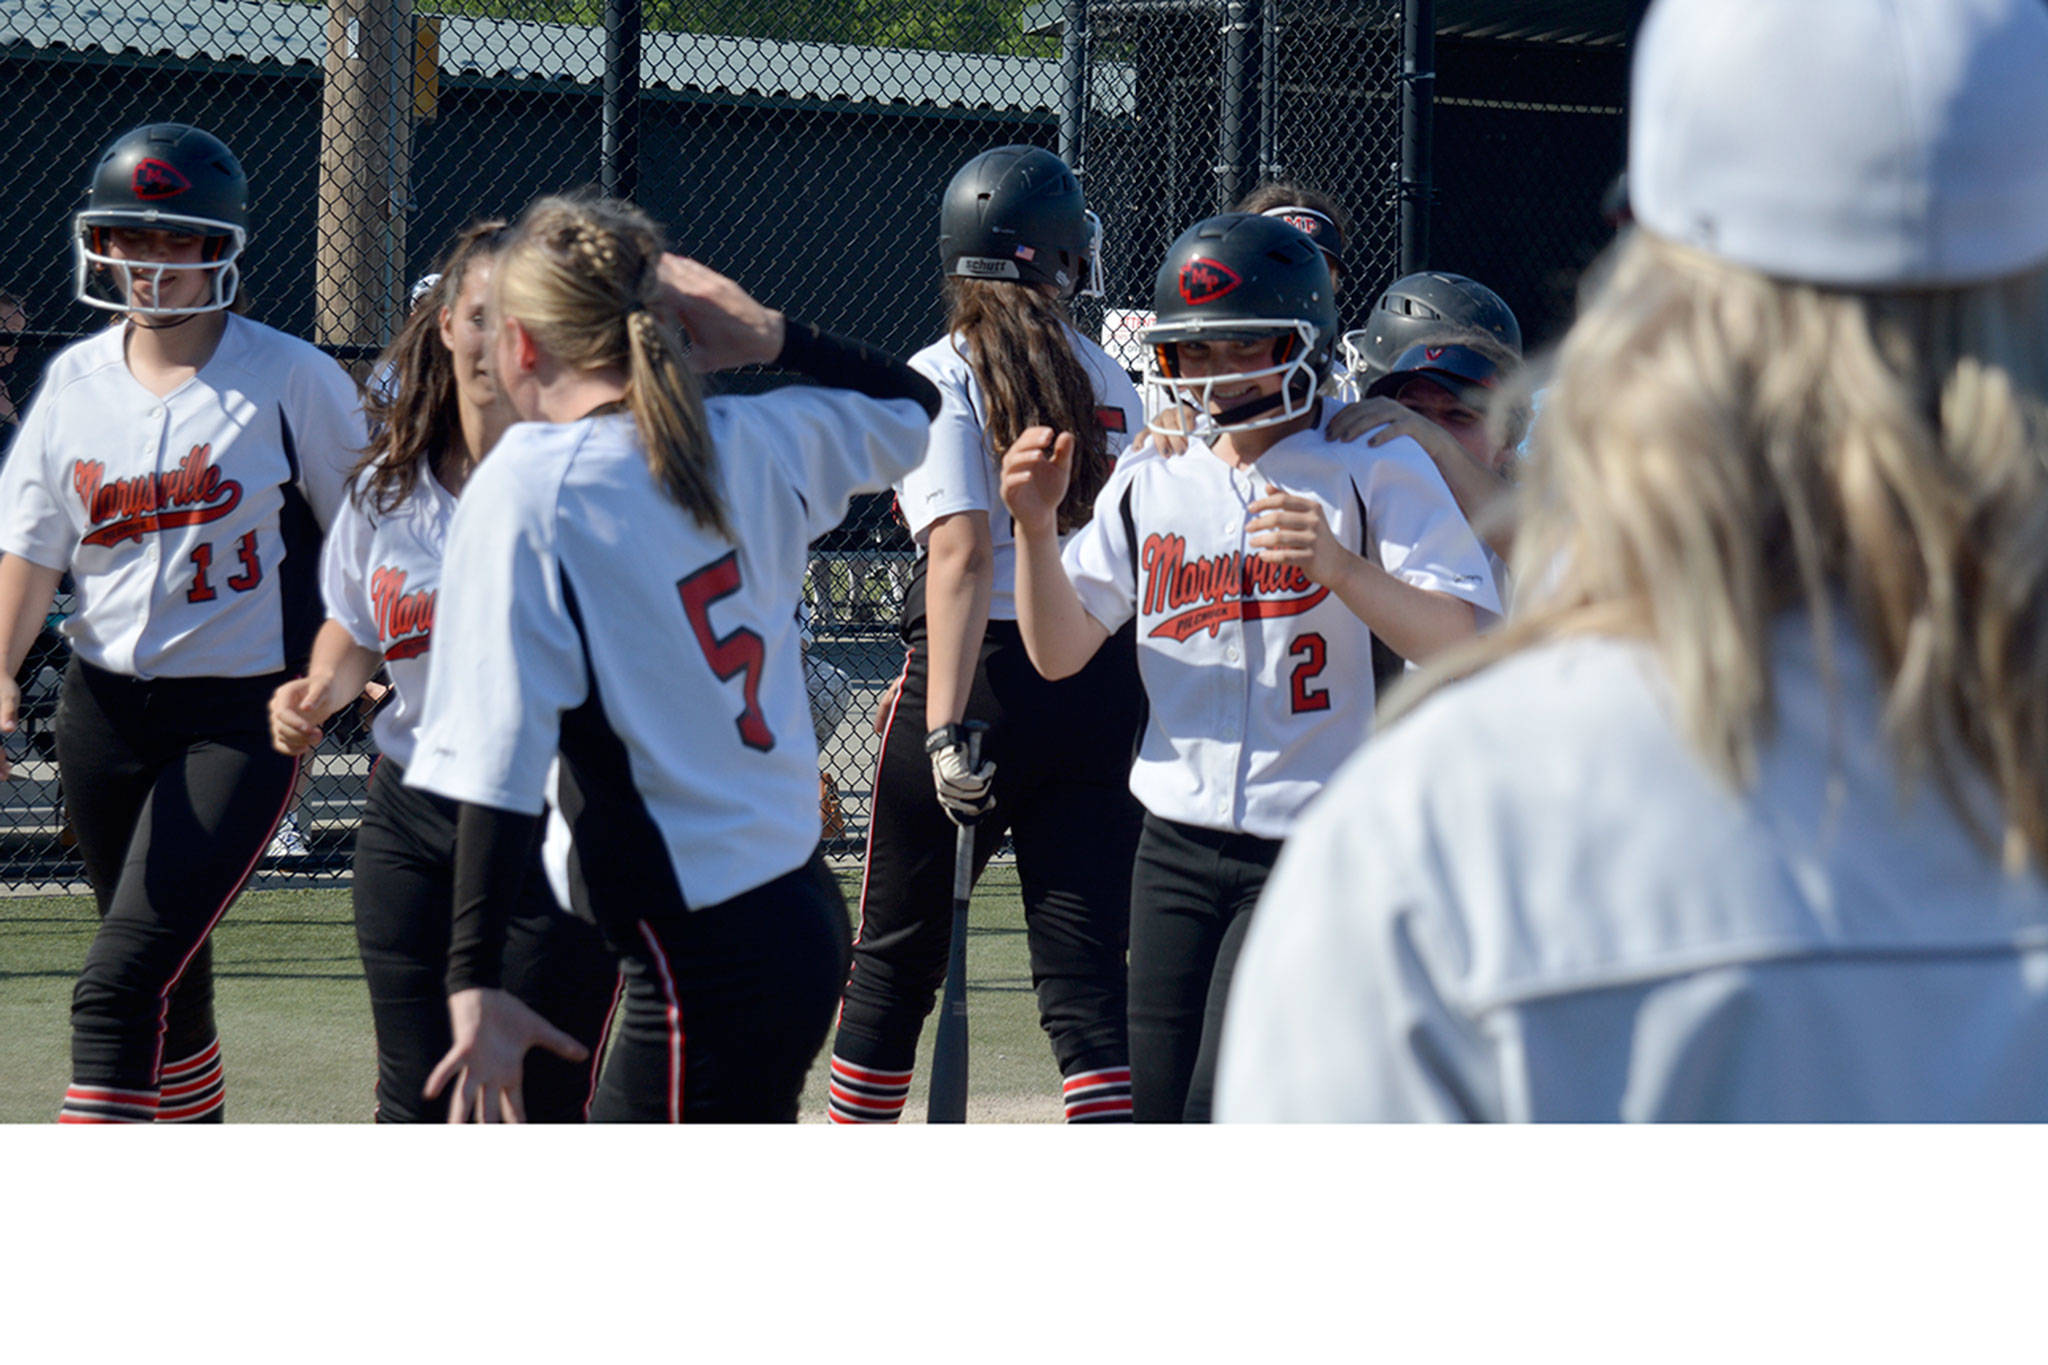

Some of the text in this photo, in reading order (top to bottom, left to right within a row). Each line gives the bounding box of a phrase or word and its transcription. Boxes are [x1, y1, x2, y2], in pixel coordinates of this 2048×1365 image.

[966, 258, 1006, 272] schutt
[1191, 267, 1218, 292] MP
[74, 442, 222, 543] Marysville
[187, 529, 262, 604] 13
[675, 549, 776, 753] 5
[1289, 631, 1331, 715] 2
